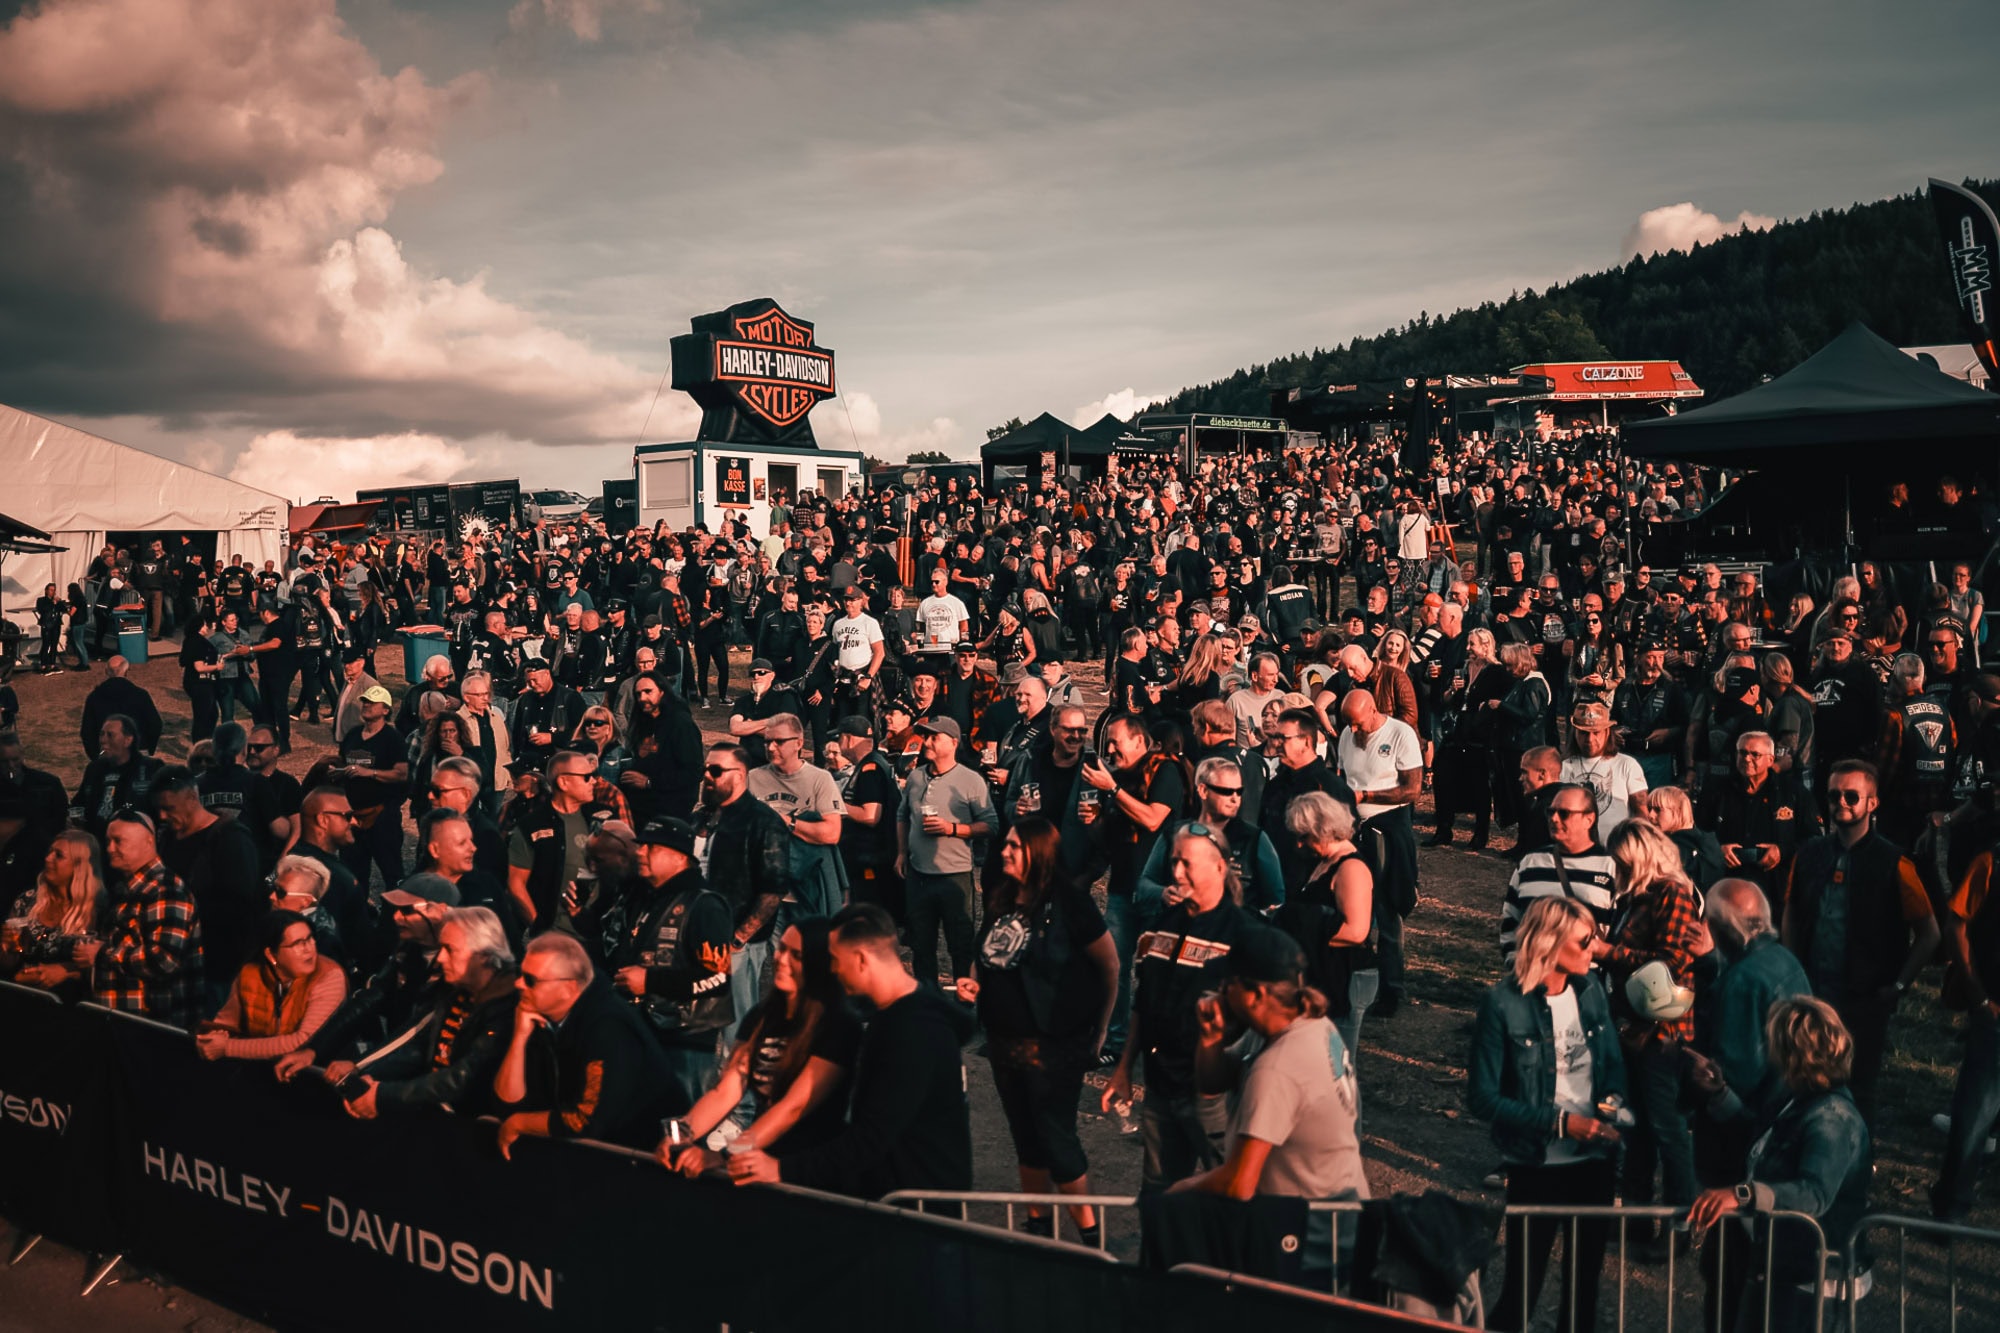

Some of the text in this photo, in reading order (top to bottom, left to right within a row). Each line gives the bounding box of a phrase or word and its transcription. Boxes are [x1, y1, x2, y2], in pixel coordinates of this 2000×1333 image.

[747, 316, 805, 348] MOTOR
[722, 347, 829, 386] HARLEY-DAVIDSON
[1582, 365, 1645, 381] CALZONE
[750, 384, 808, 420] CYCLES
[1209, 417, 1271, 429] diebackhuette.de
[728, 469, 742, 480] BON
[724, 480, 746, 492] KASSE
[1280, 592, 1304, 602] INDIAN
[1906, 703, 1943, 714] SPIDERS
